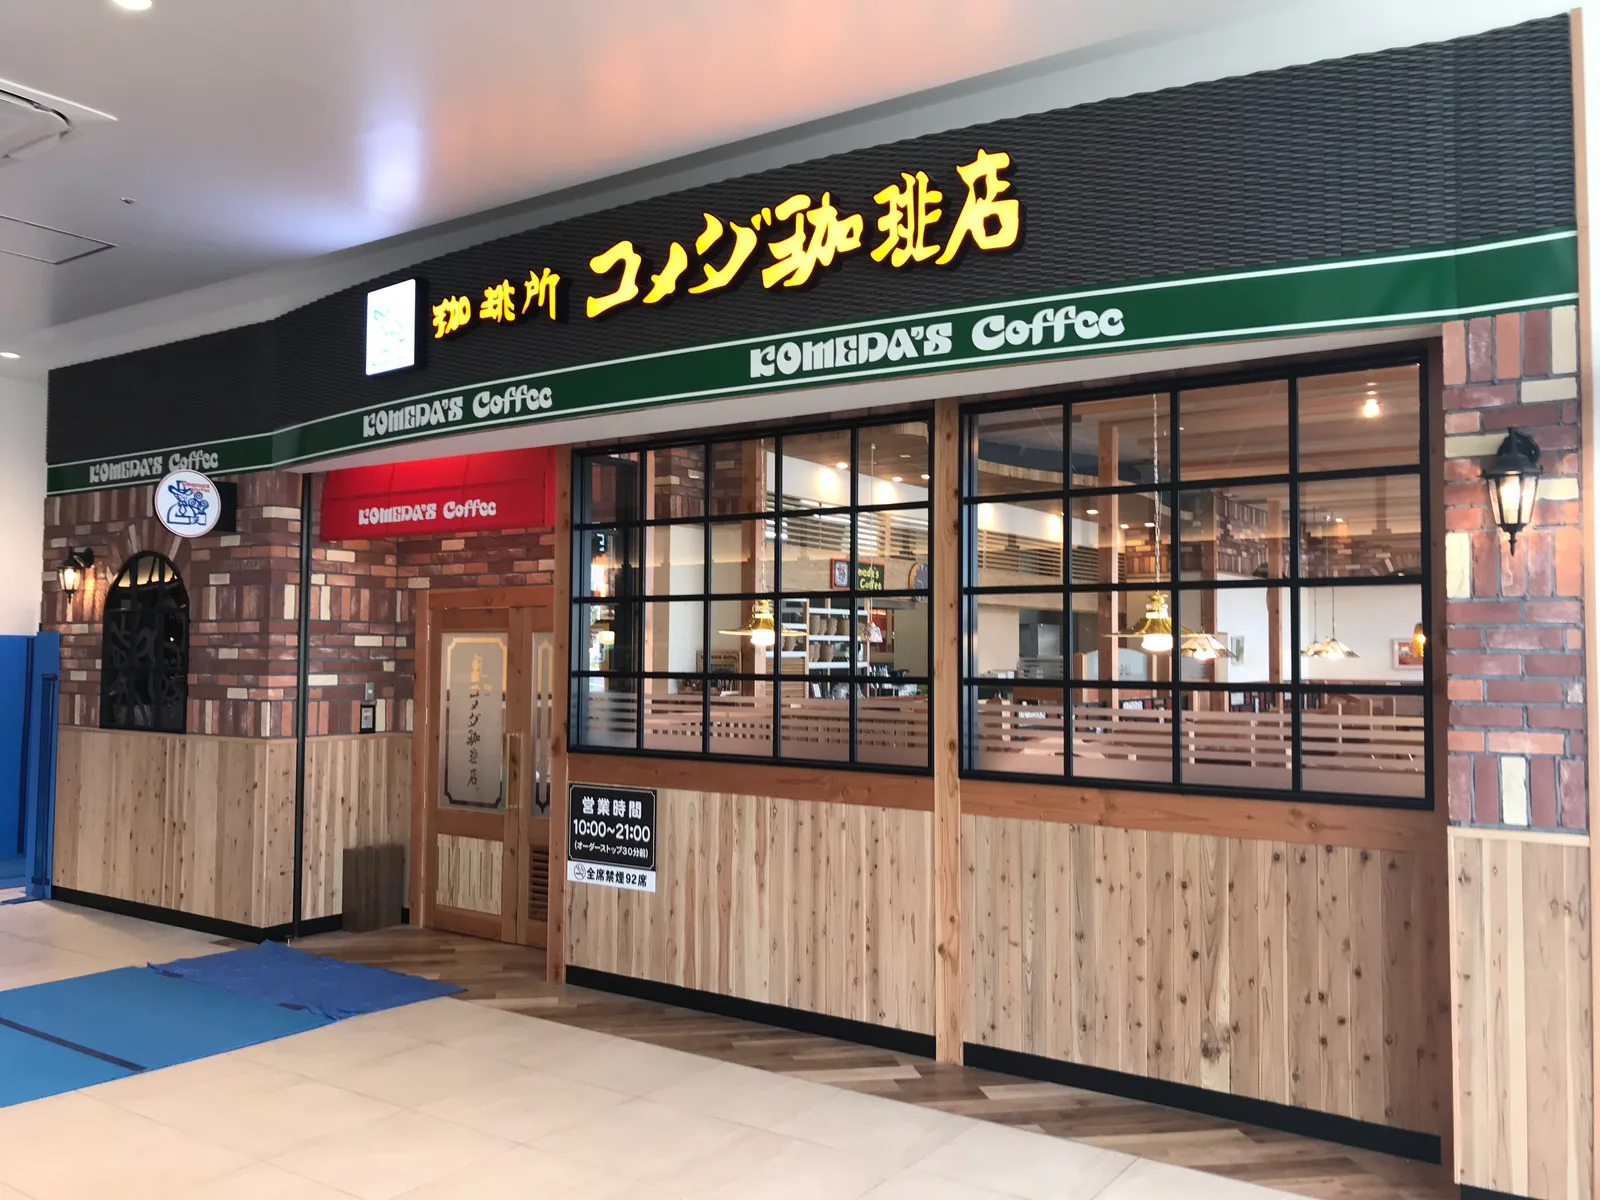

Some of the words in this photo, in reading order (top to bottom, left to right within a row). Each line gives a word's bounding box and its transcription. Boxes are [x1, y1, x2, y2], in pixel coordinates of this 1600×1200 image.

[432, 267, 561, 340] 珈琲所
[586, 148, 1021, 318] コメダ珈琲店
[750, 321, 953, 379] KOMEDA'S
[971, 305, 1126, 351] Coffee
[363, 396, 464, 438] KOMEDA'S
[472, 384, 553, 419] Coffee
[89, 456, 163, 483] KOMEDA'S
[168, 449, 219, 473] Coffee
[358, 503, 437, 525] KOMEDA'S
[443, 498, 497, 520] Coffee
[581, 795, 642, 820] 営業時間
[586, 867, 647, 887] 全席禁煙92席
